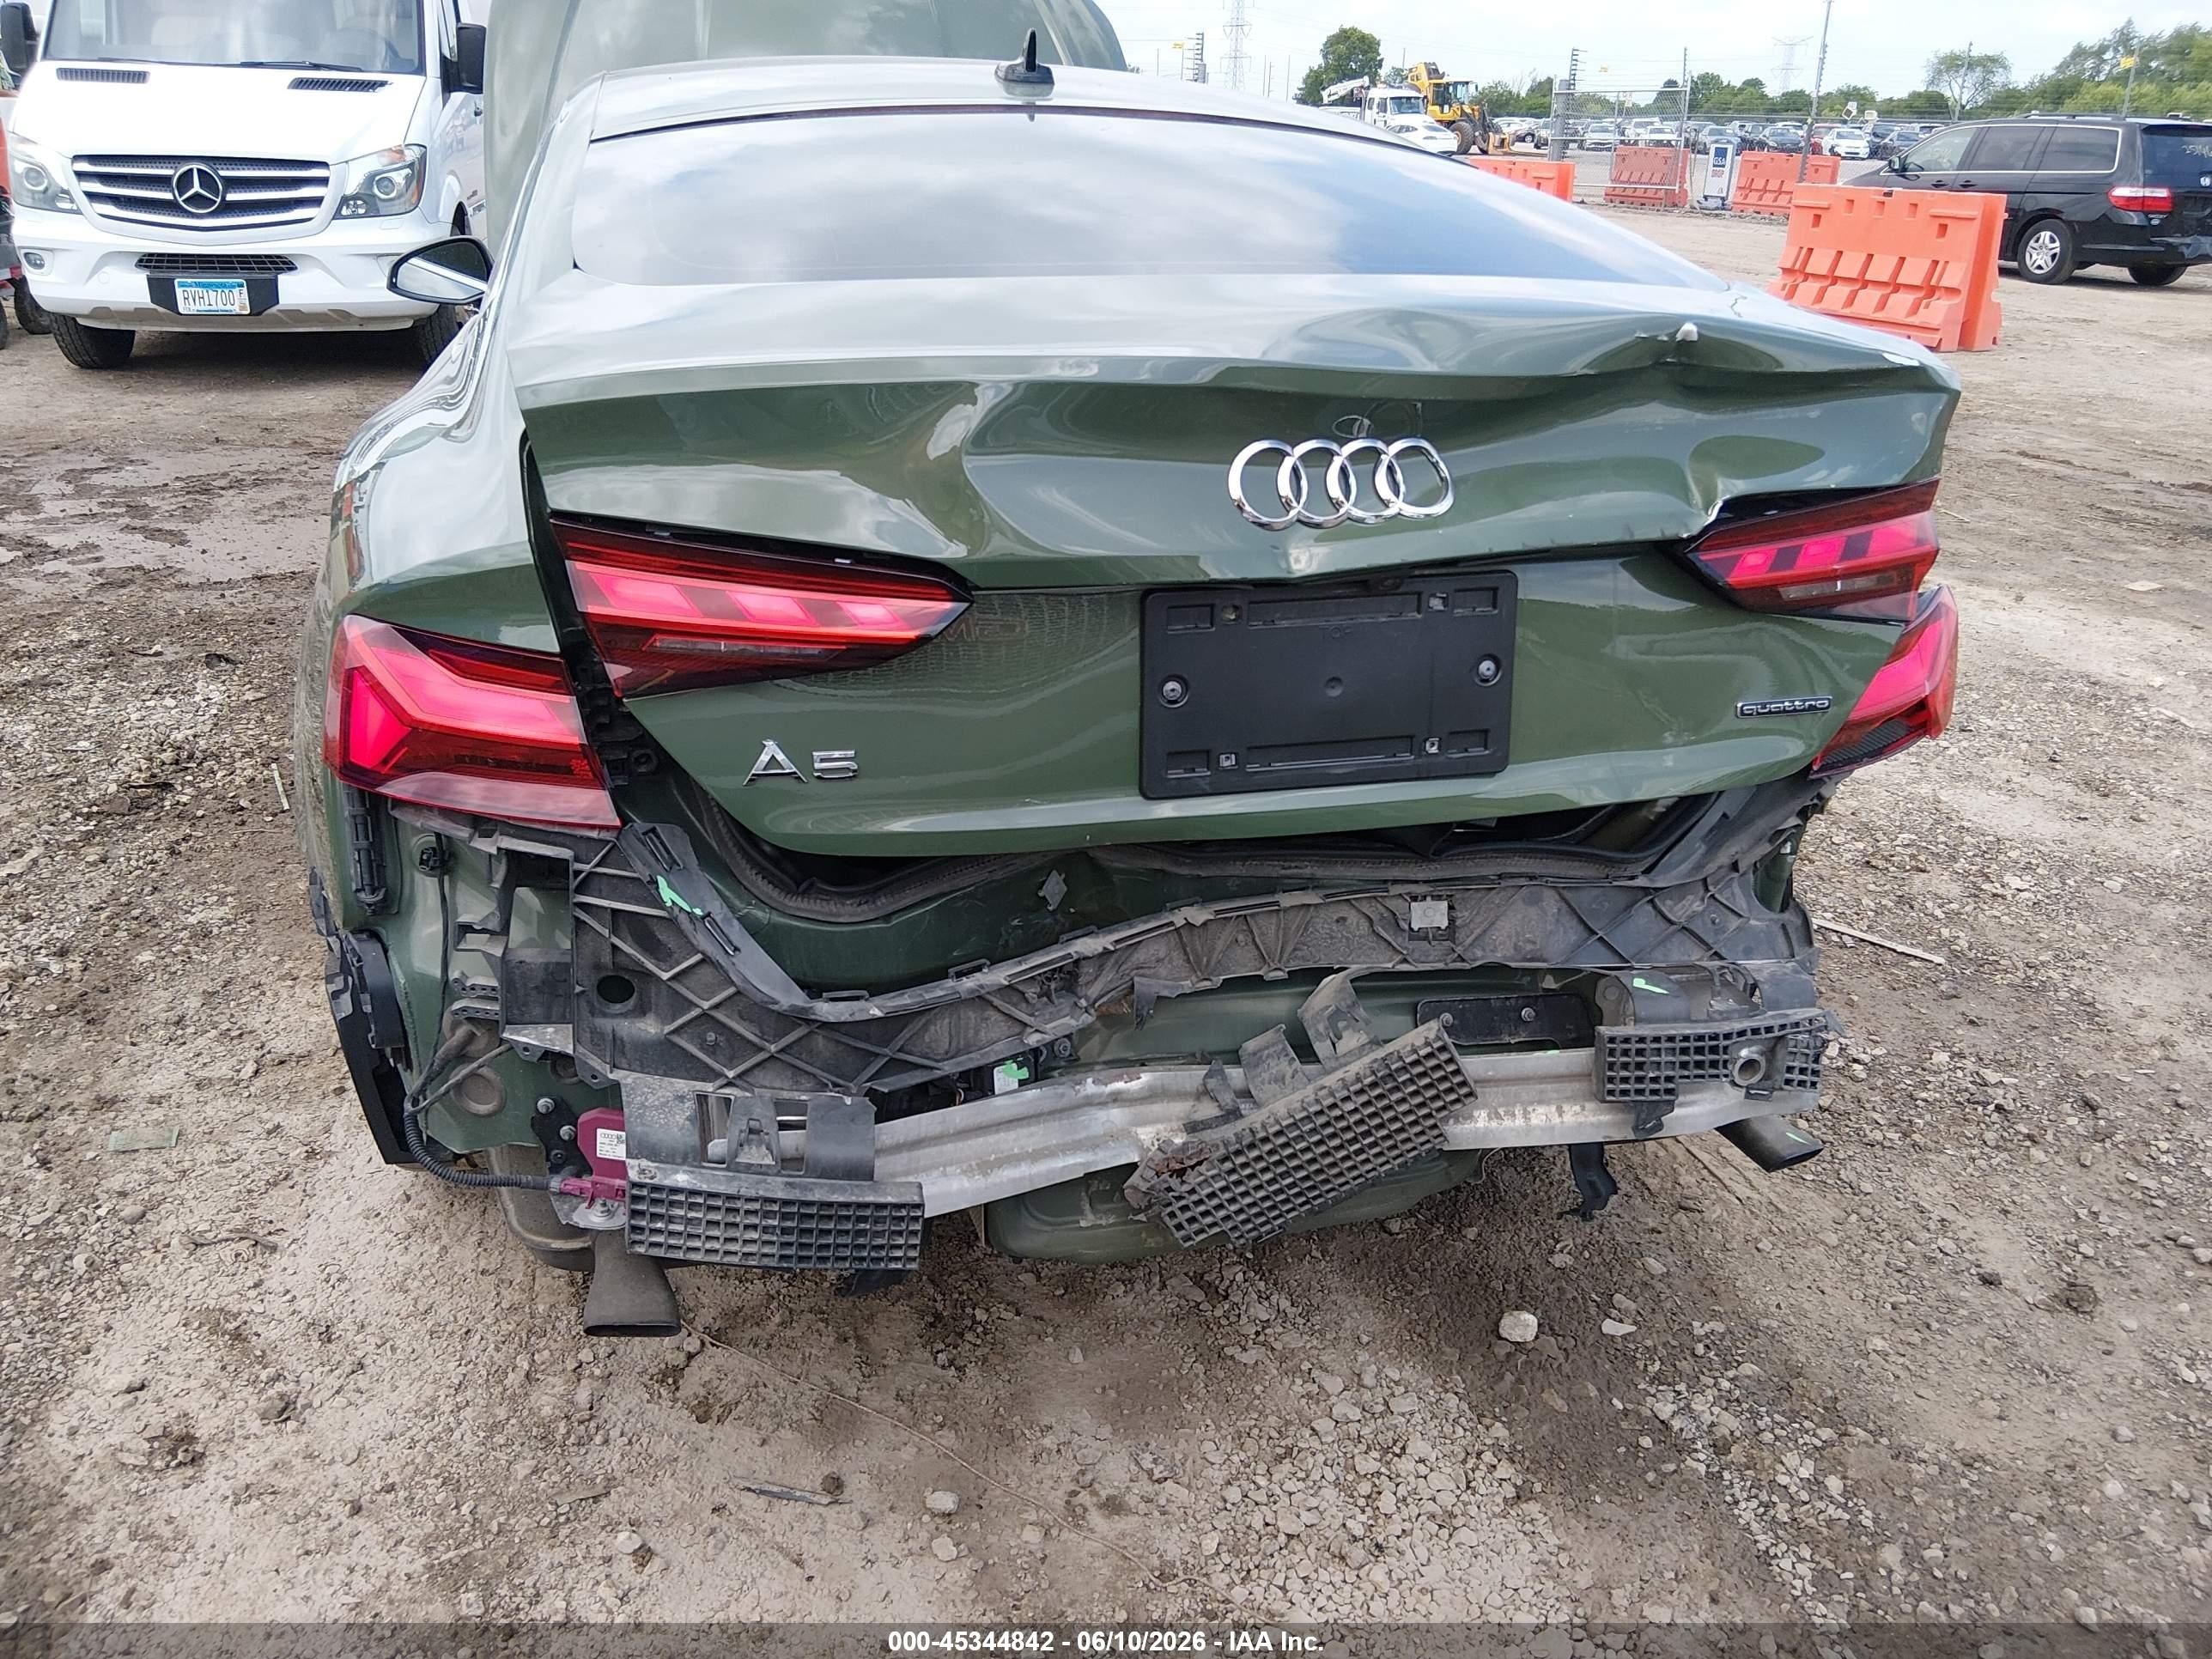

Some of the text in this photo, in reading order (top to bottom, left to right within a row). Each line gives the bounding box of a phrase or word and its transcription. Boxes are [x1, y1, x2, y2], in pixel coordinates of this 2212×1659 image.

[182, 289, 235, 307] RVH1700
[1742, 700, 1829, 715] quattro
[742, 738, 859, 787] A5
